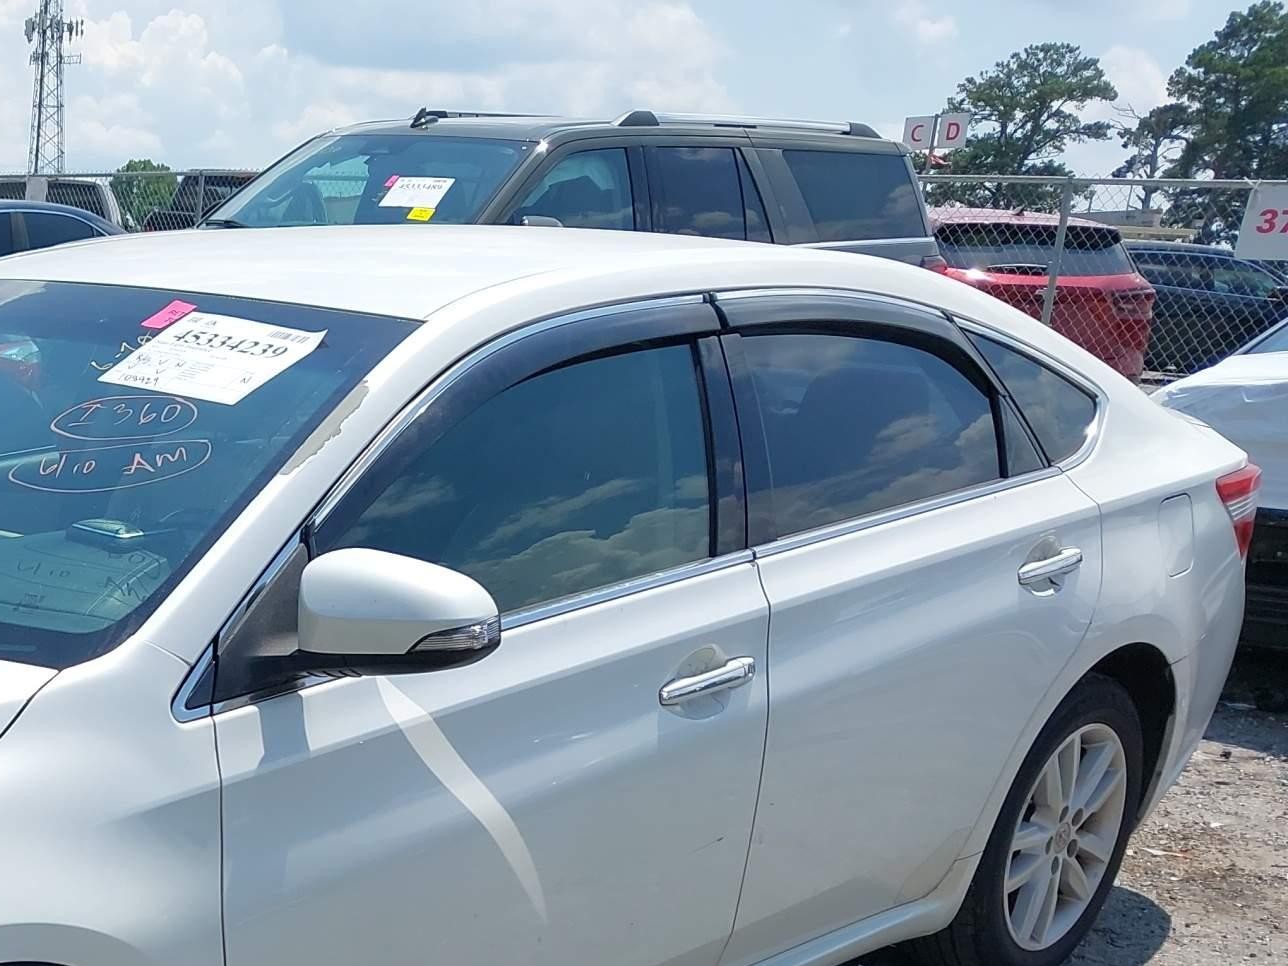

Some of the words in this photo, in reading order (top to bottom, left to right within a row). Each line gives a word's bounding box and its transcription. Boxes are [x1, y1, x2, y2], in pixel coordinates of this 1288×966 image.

[911, 124, 924, 142] C
[946, 122, 960, 141] D
[173, 329, 289, 359] 45334239
